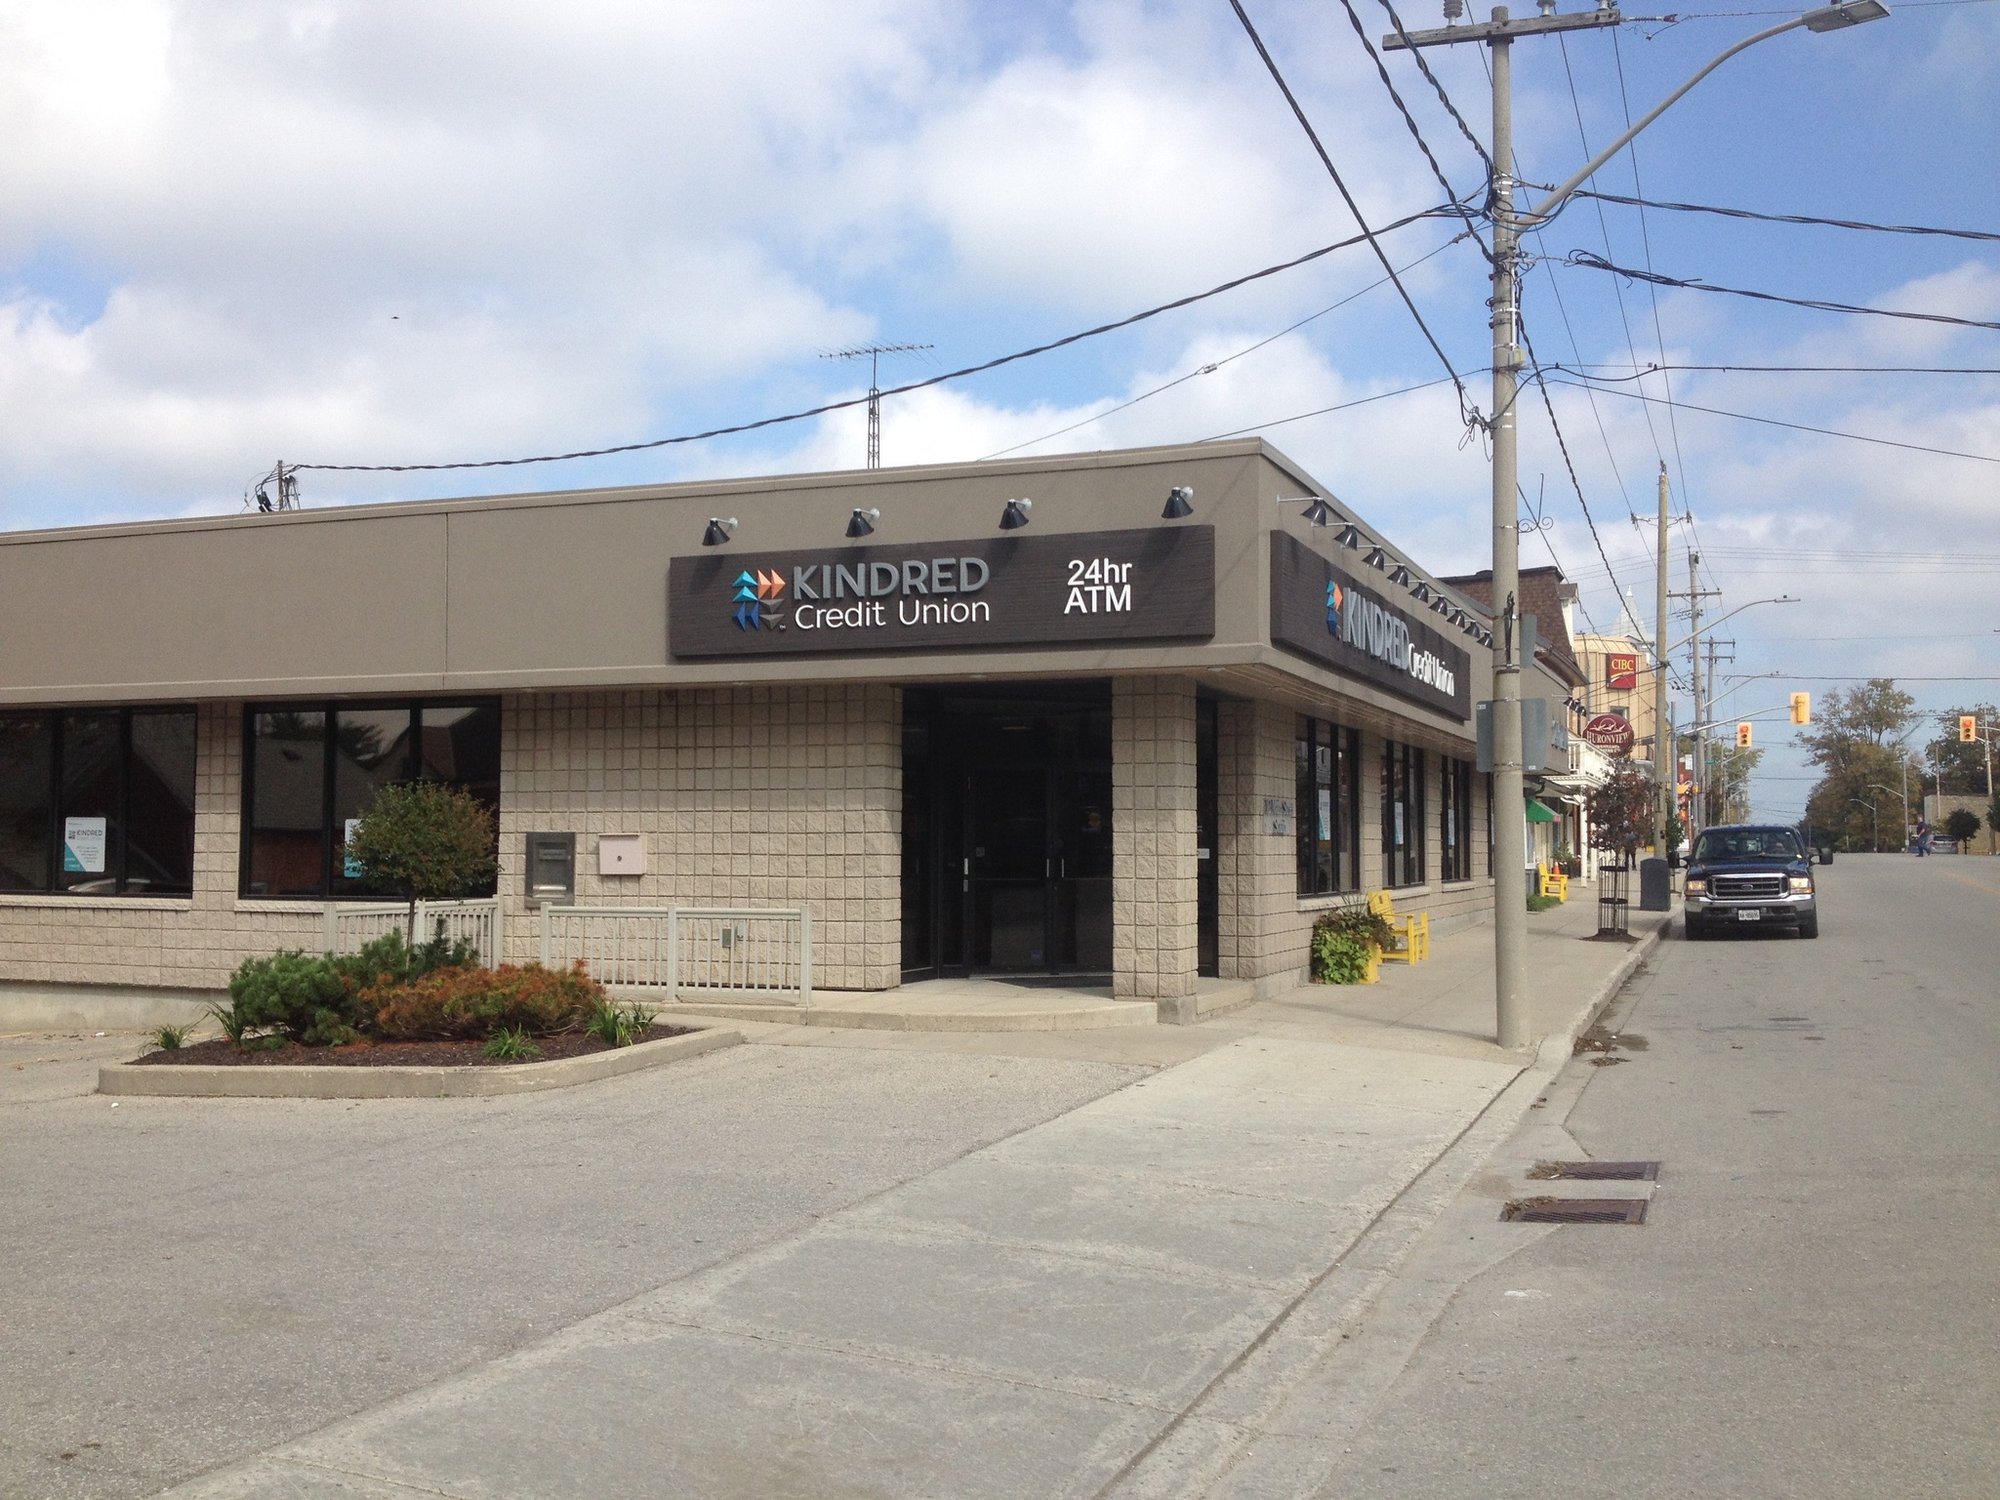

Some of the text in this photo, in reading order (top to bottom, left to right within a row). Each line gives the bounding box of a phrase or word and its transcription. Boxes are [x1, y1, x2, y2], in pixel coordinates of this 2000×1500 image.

[793, 557, 988, 599] KINDRED
[1068, 559, 1132, 584] 24hr
[794, 598, 989, 629] Credit Union
[1064, 584, 1131, 614] ATM
[1343, 587, 1410, 670] KINDRED
[1408, 643, 1433, 685] Credit
[1611, 659, 1634, 670] CIBC
